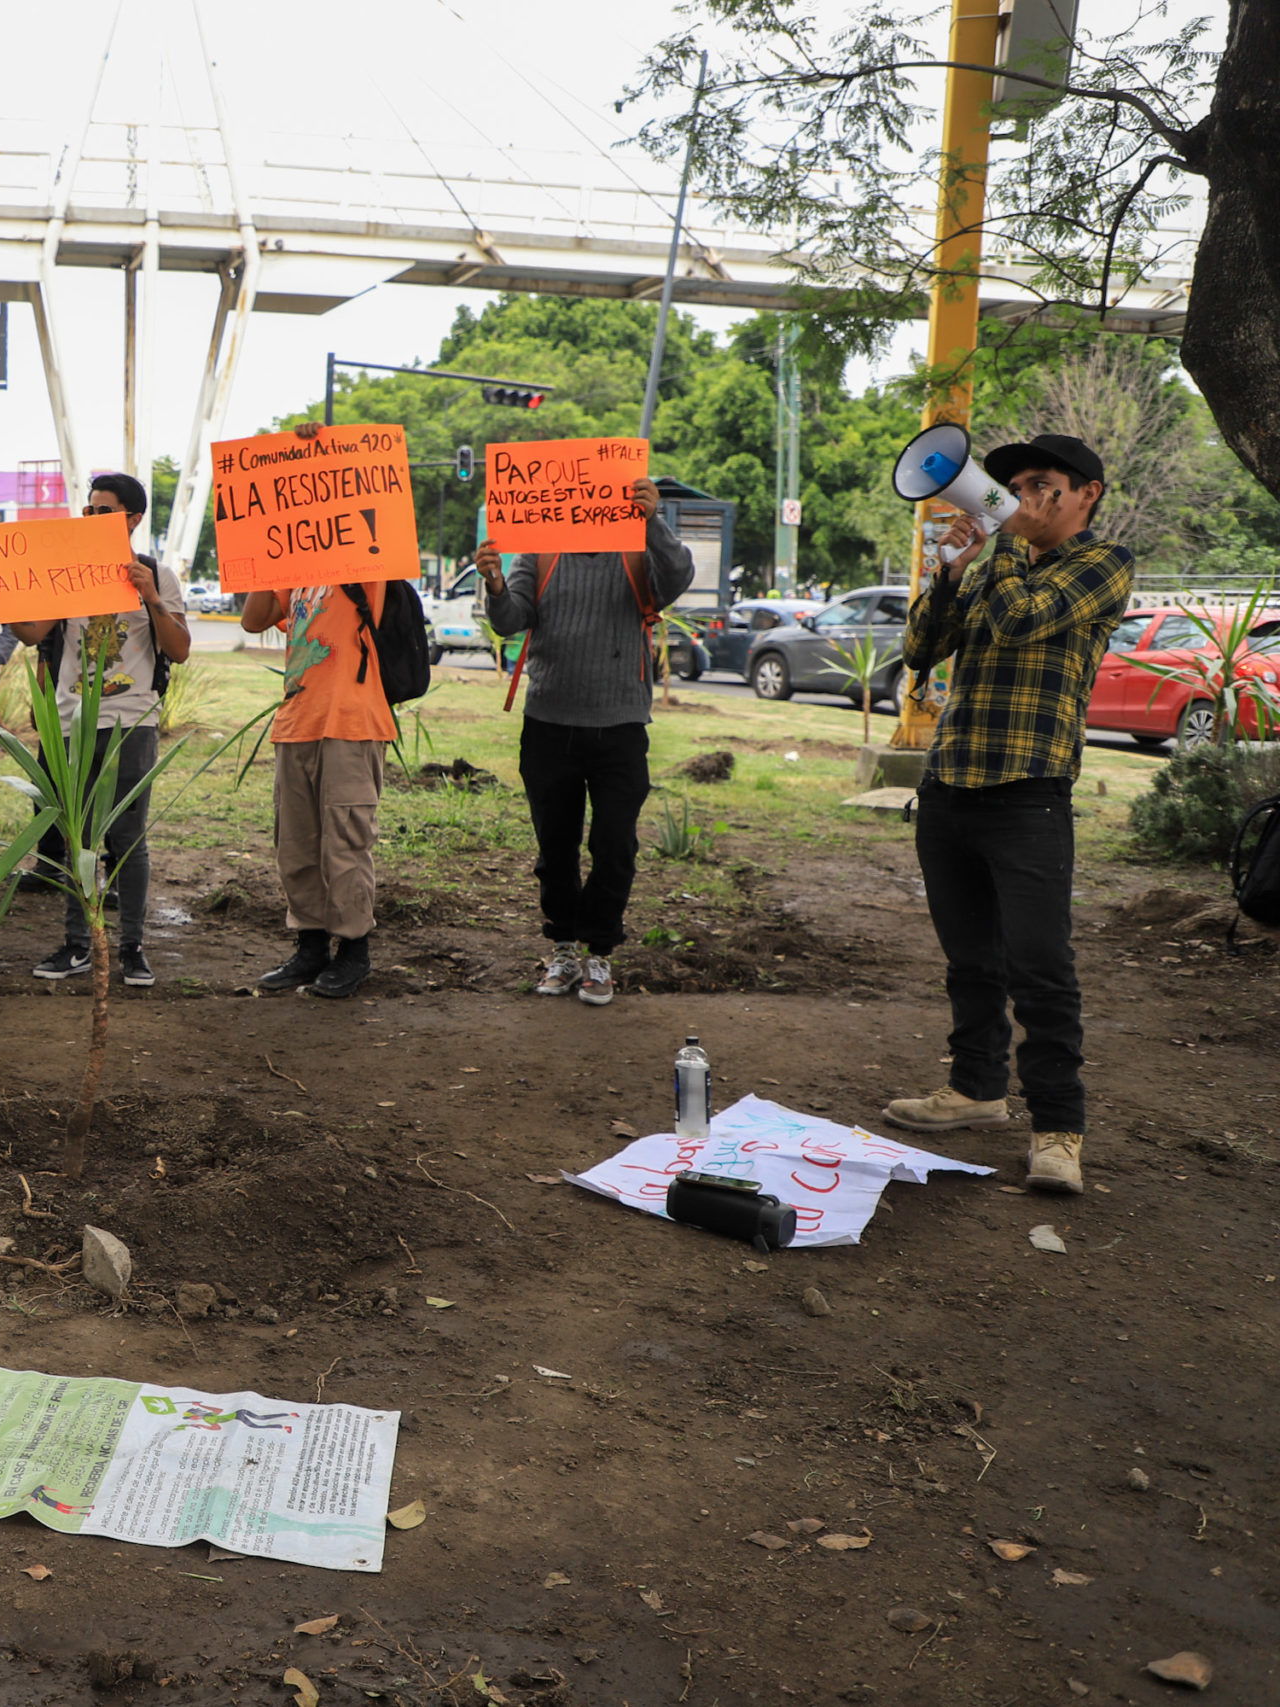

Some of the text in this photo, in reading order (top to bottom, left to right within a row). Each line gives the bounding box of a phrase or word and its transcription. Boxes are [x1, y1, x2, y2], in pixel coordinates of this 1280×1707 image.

[597, 444, 646, 462] #PALE
[495, 452, 592, 487] PARQUE
[274, 464, 403, 511] RESISTENCIA
[488, 485, 613, 506] AUTOGESTIVO
[488, 509, 506, 524] LA
[512, 507, 565, 524] LIBRE
[14, 568, 42, 590] LA
[44, 1402, 60, 1414] DE
[109, 1416, 124, 1427] DE
[19, 1451, 33, 1459] DE
[7, 1459, 30, 1485] CASO
[3, 1485, 18, 1497] EN
